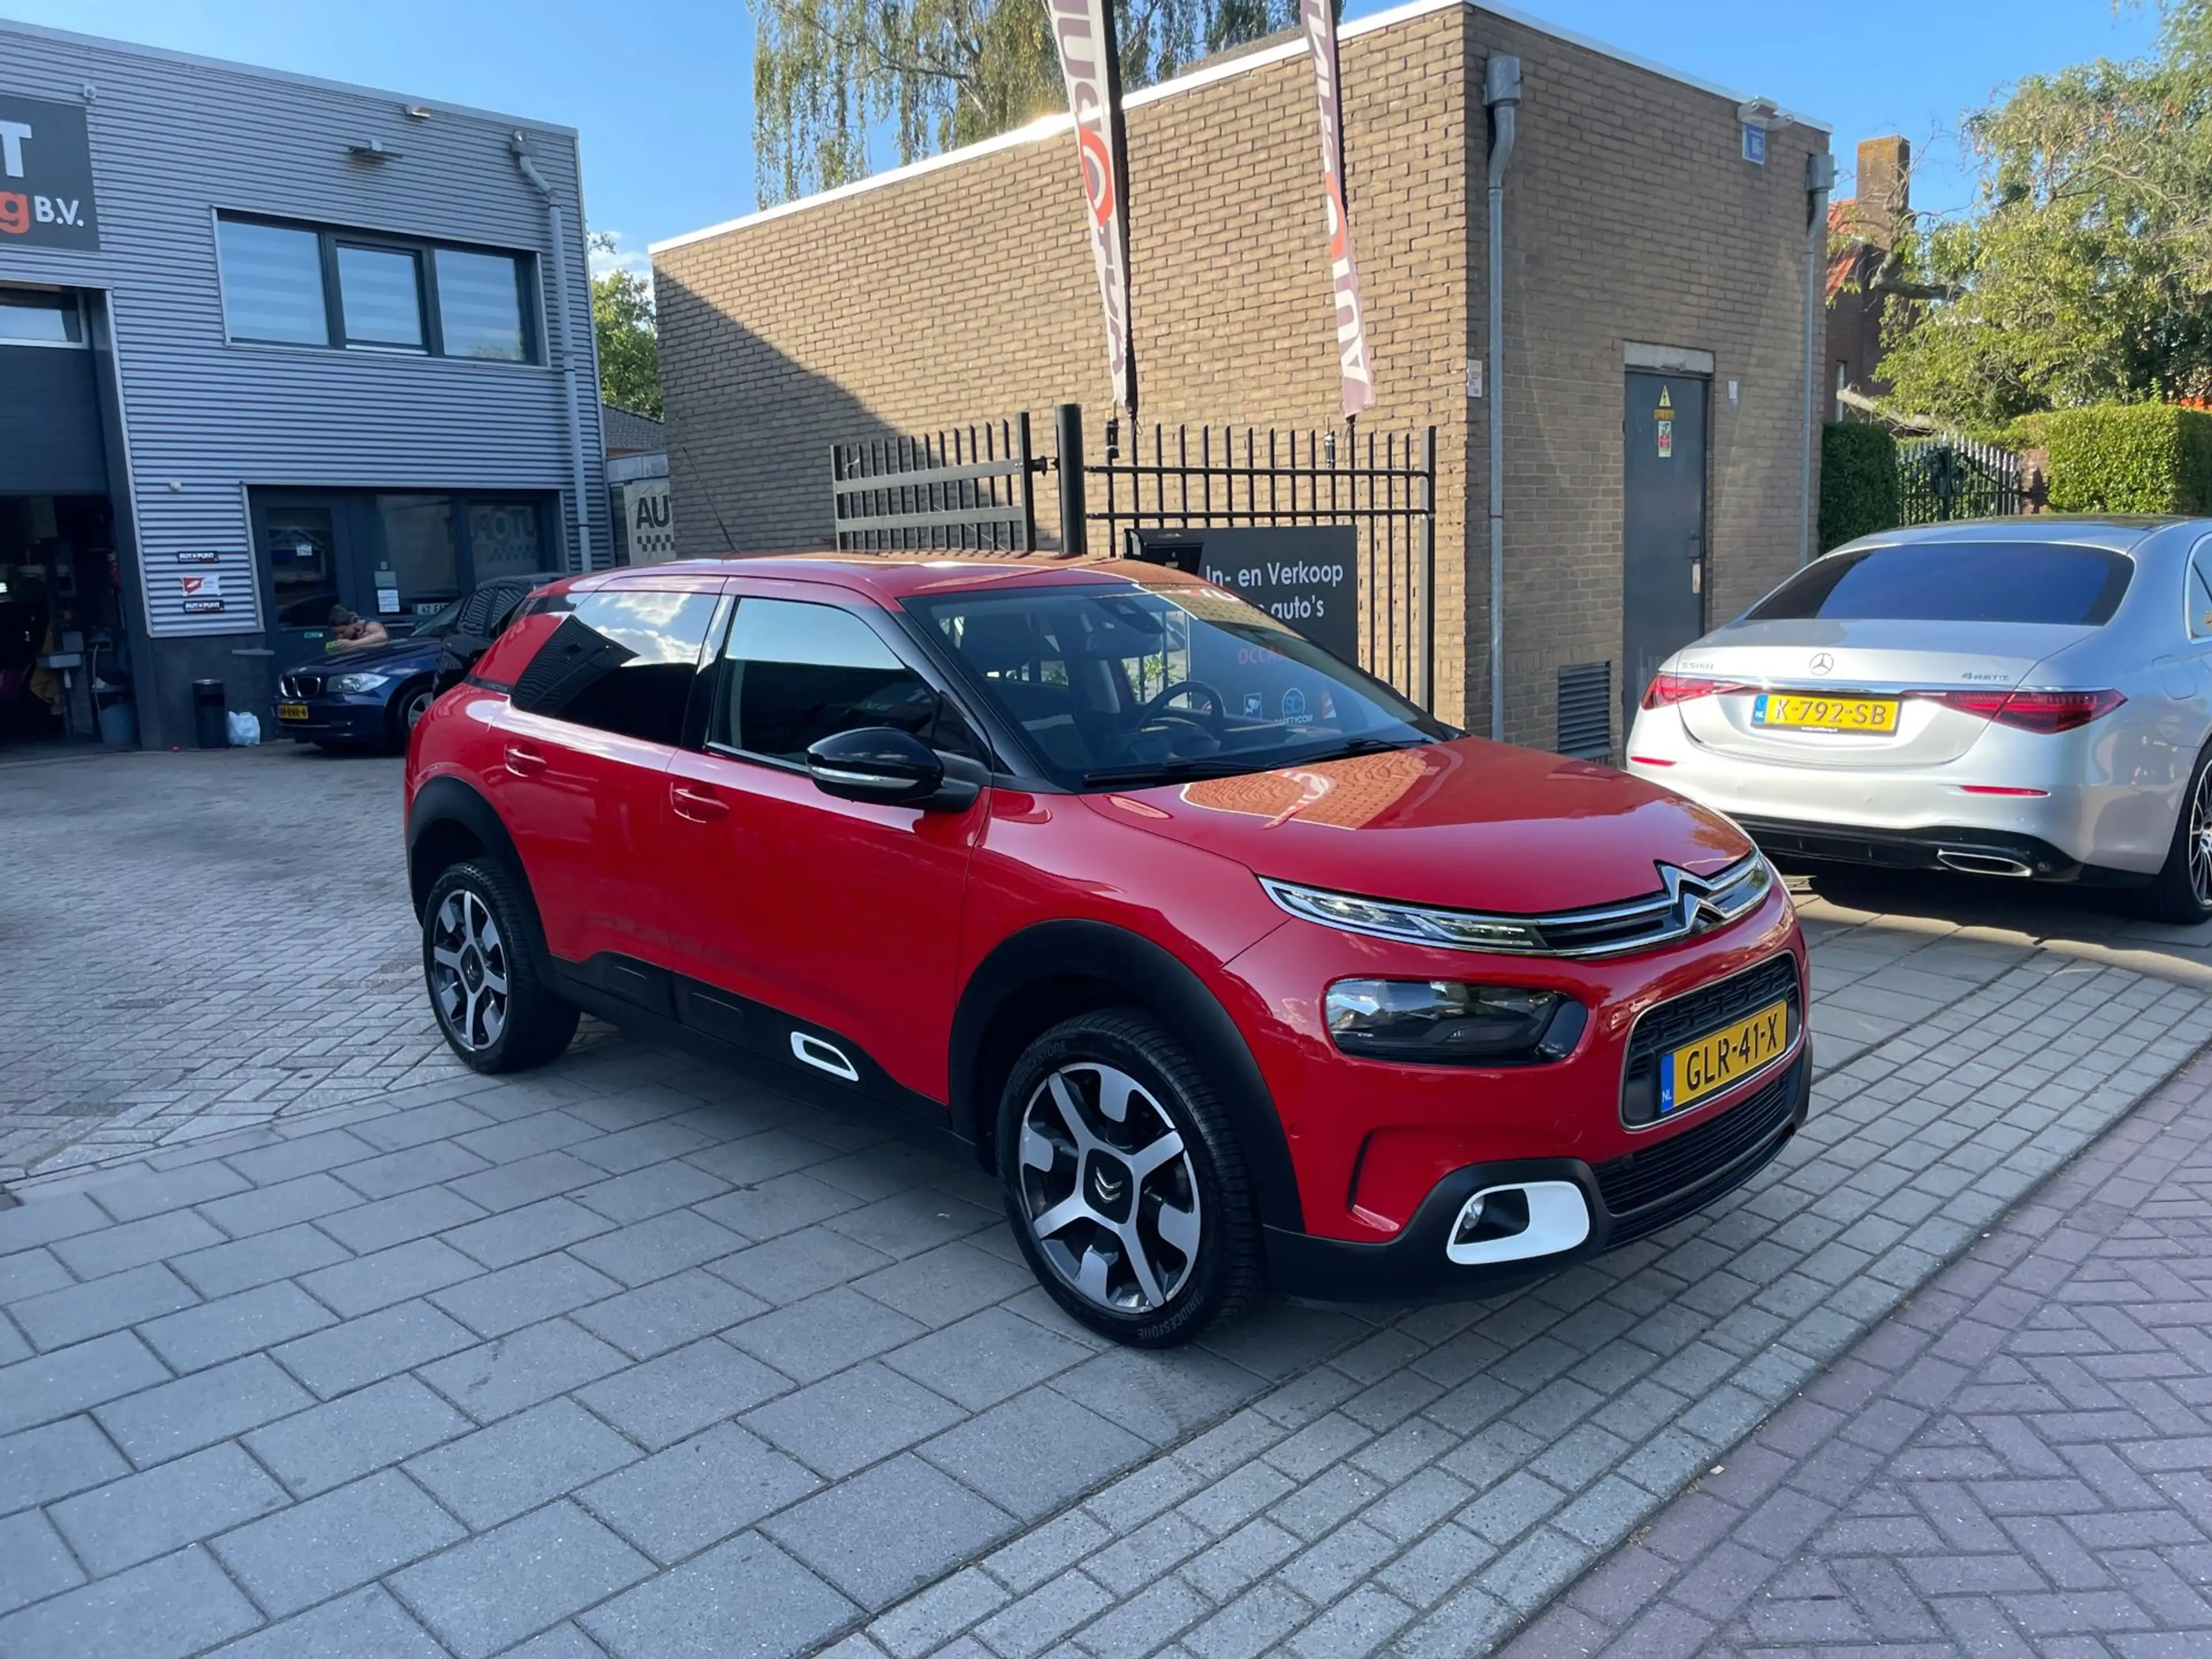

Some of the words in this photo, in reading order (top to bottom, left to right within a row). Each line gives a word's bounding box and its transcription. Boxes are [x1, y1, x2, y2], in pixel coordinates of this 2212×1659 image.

[34, 195, 84, 227] B.V.
[636, 495, 672, 529] AU
[1206, 565, 1231, 586] In-
[1238, 567, 1262, 588] en
[1267, 560, 1343, 588] Verkoop
[1271, 594, 1324, 620] auto's
[1775, 699, 1887, 726] K-792-SB
[1661, 1088, 1672, 1103] NL
[1687, 1012, 1778, 1092] GLR-41-X
